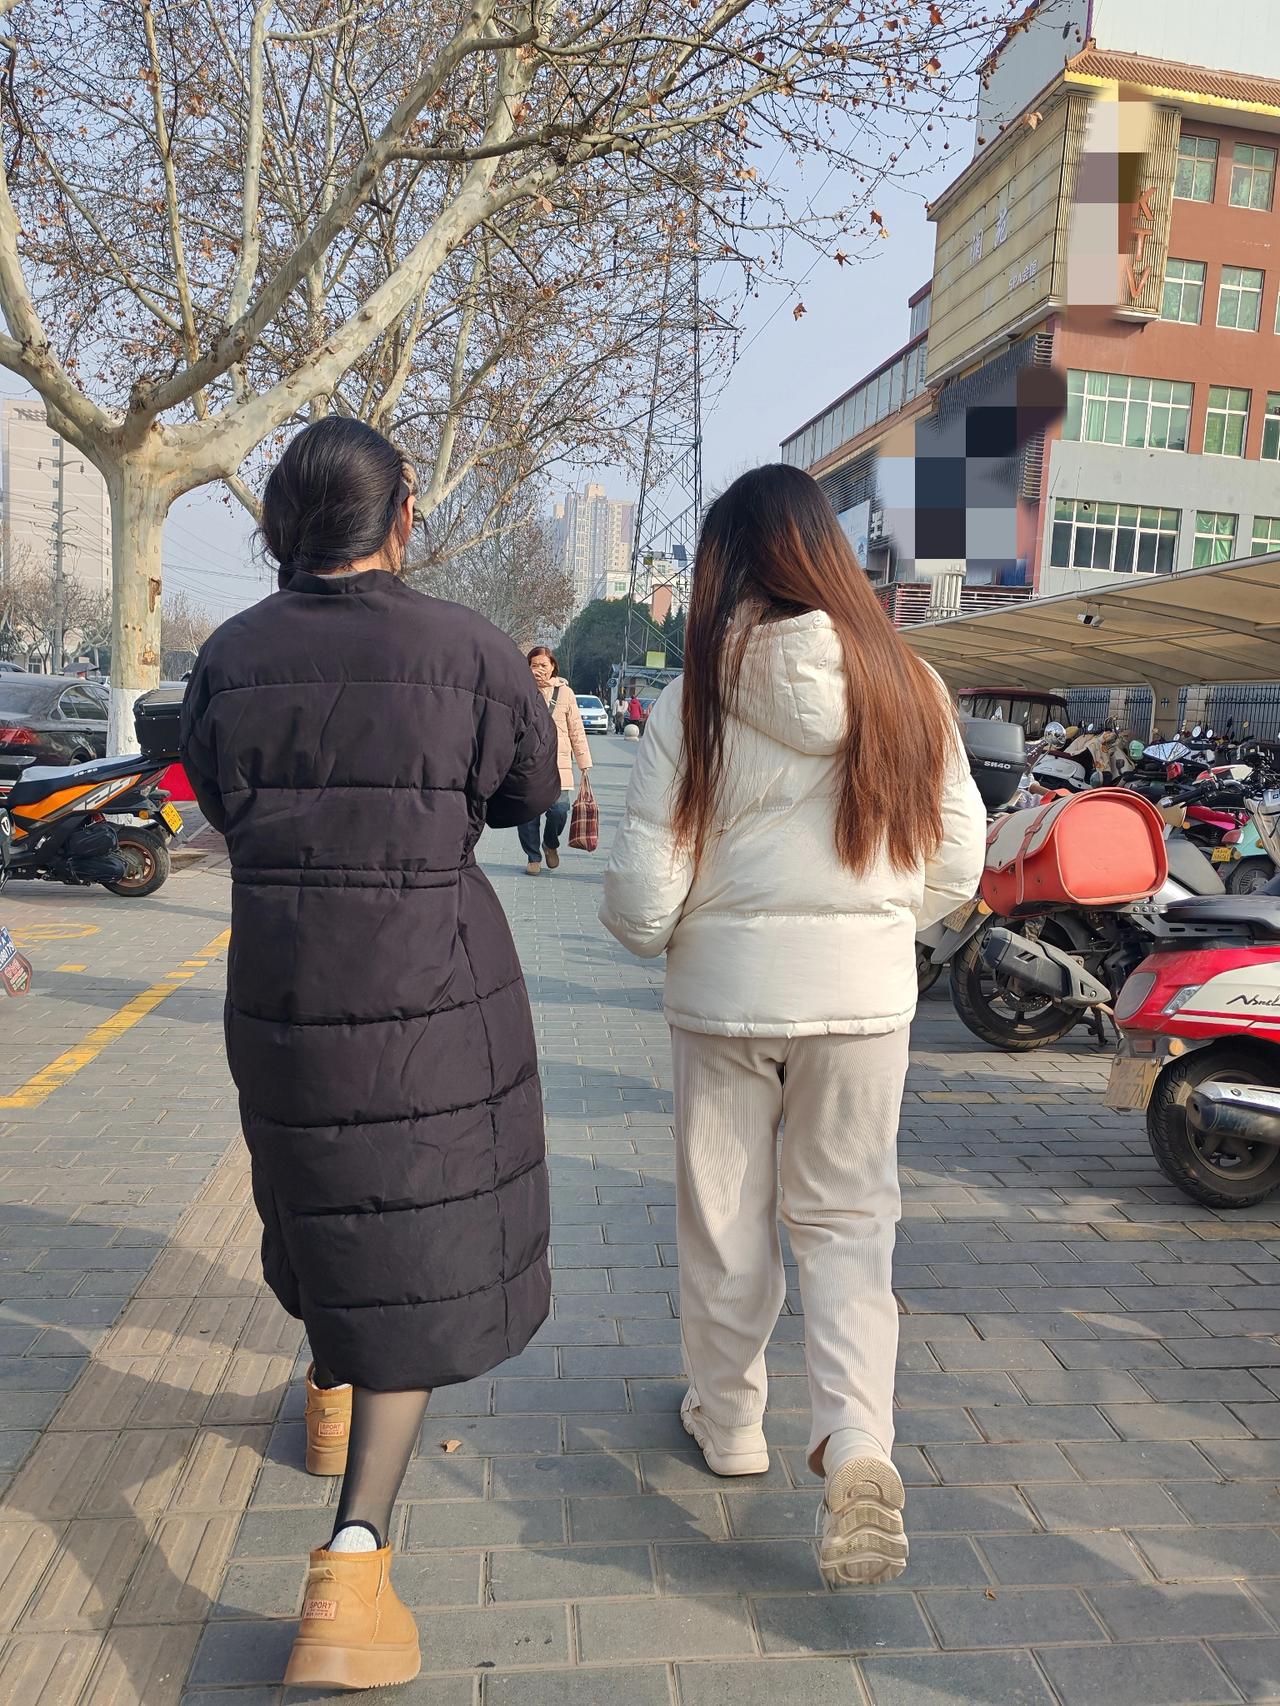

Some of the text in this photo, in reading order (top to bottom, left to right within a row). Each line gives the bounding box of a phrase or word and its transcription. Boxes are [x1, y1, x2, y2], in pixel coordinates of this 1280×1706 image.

[1126, 186, 1157, 298] KTV
[983, 760, 1011, 770] SH40
[309, 1601, 332, 1609] SPORT
